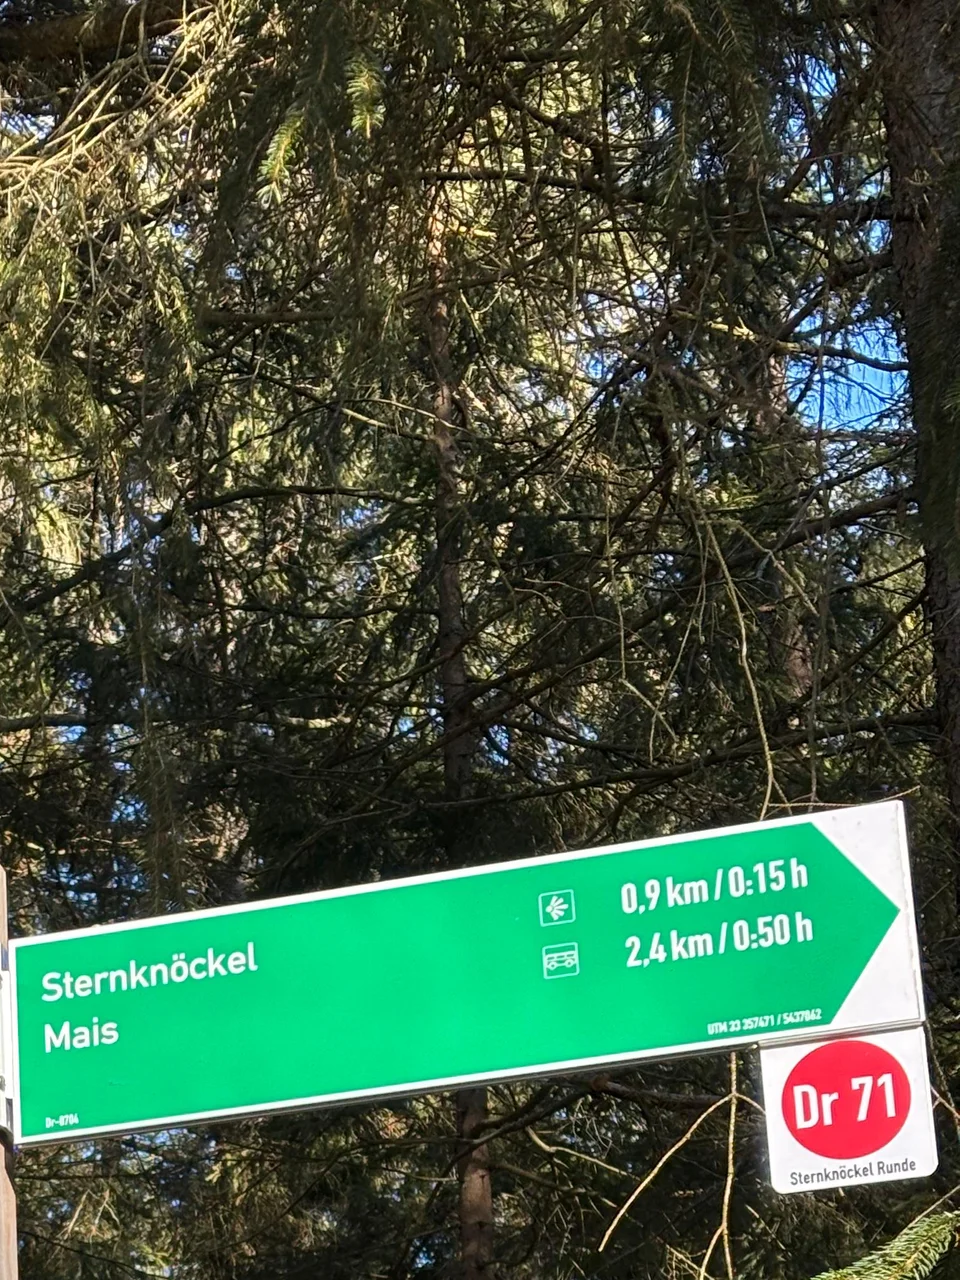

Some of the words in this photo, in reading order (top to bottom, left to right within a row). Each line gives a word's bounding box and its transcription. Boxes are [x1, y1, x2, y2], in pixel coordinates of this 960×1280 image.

[620, 878, 661, 914] 0,9
[624, 931, 667, 968] 2,4
[41, 941, 259, 1002] Sternknöckel
[44, 1016, 119, 1053] Mais
[706, 1021, 728, 1035] UTM
[792, 1083, 839, 1130] Dr
[850, 1073, 896, 1122] 71
[790, 1162, 875, 1186] Sternknöckel
[877, 1158, 917, 1176] Runde
